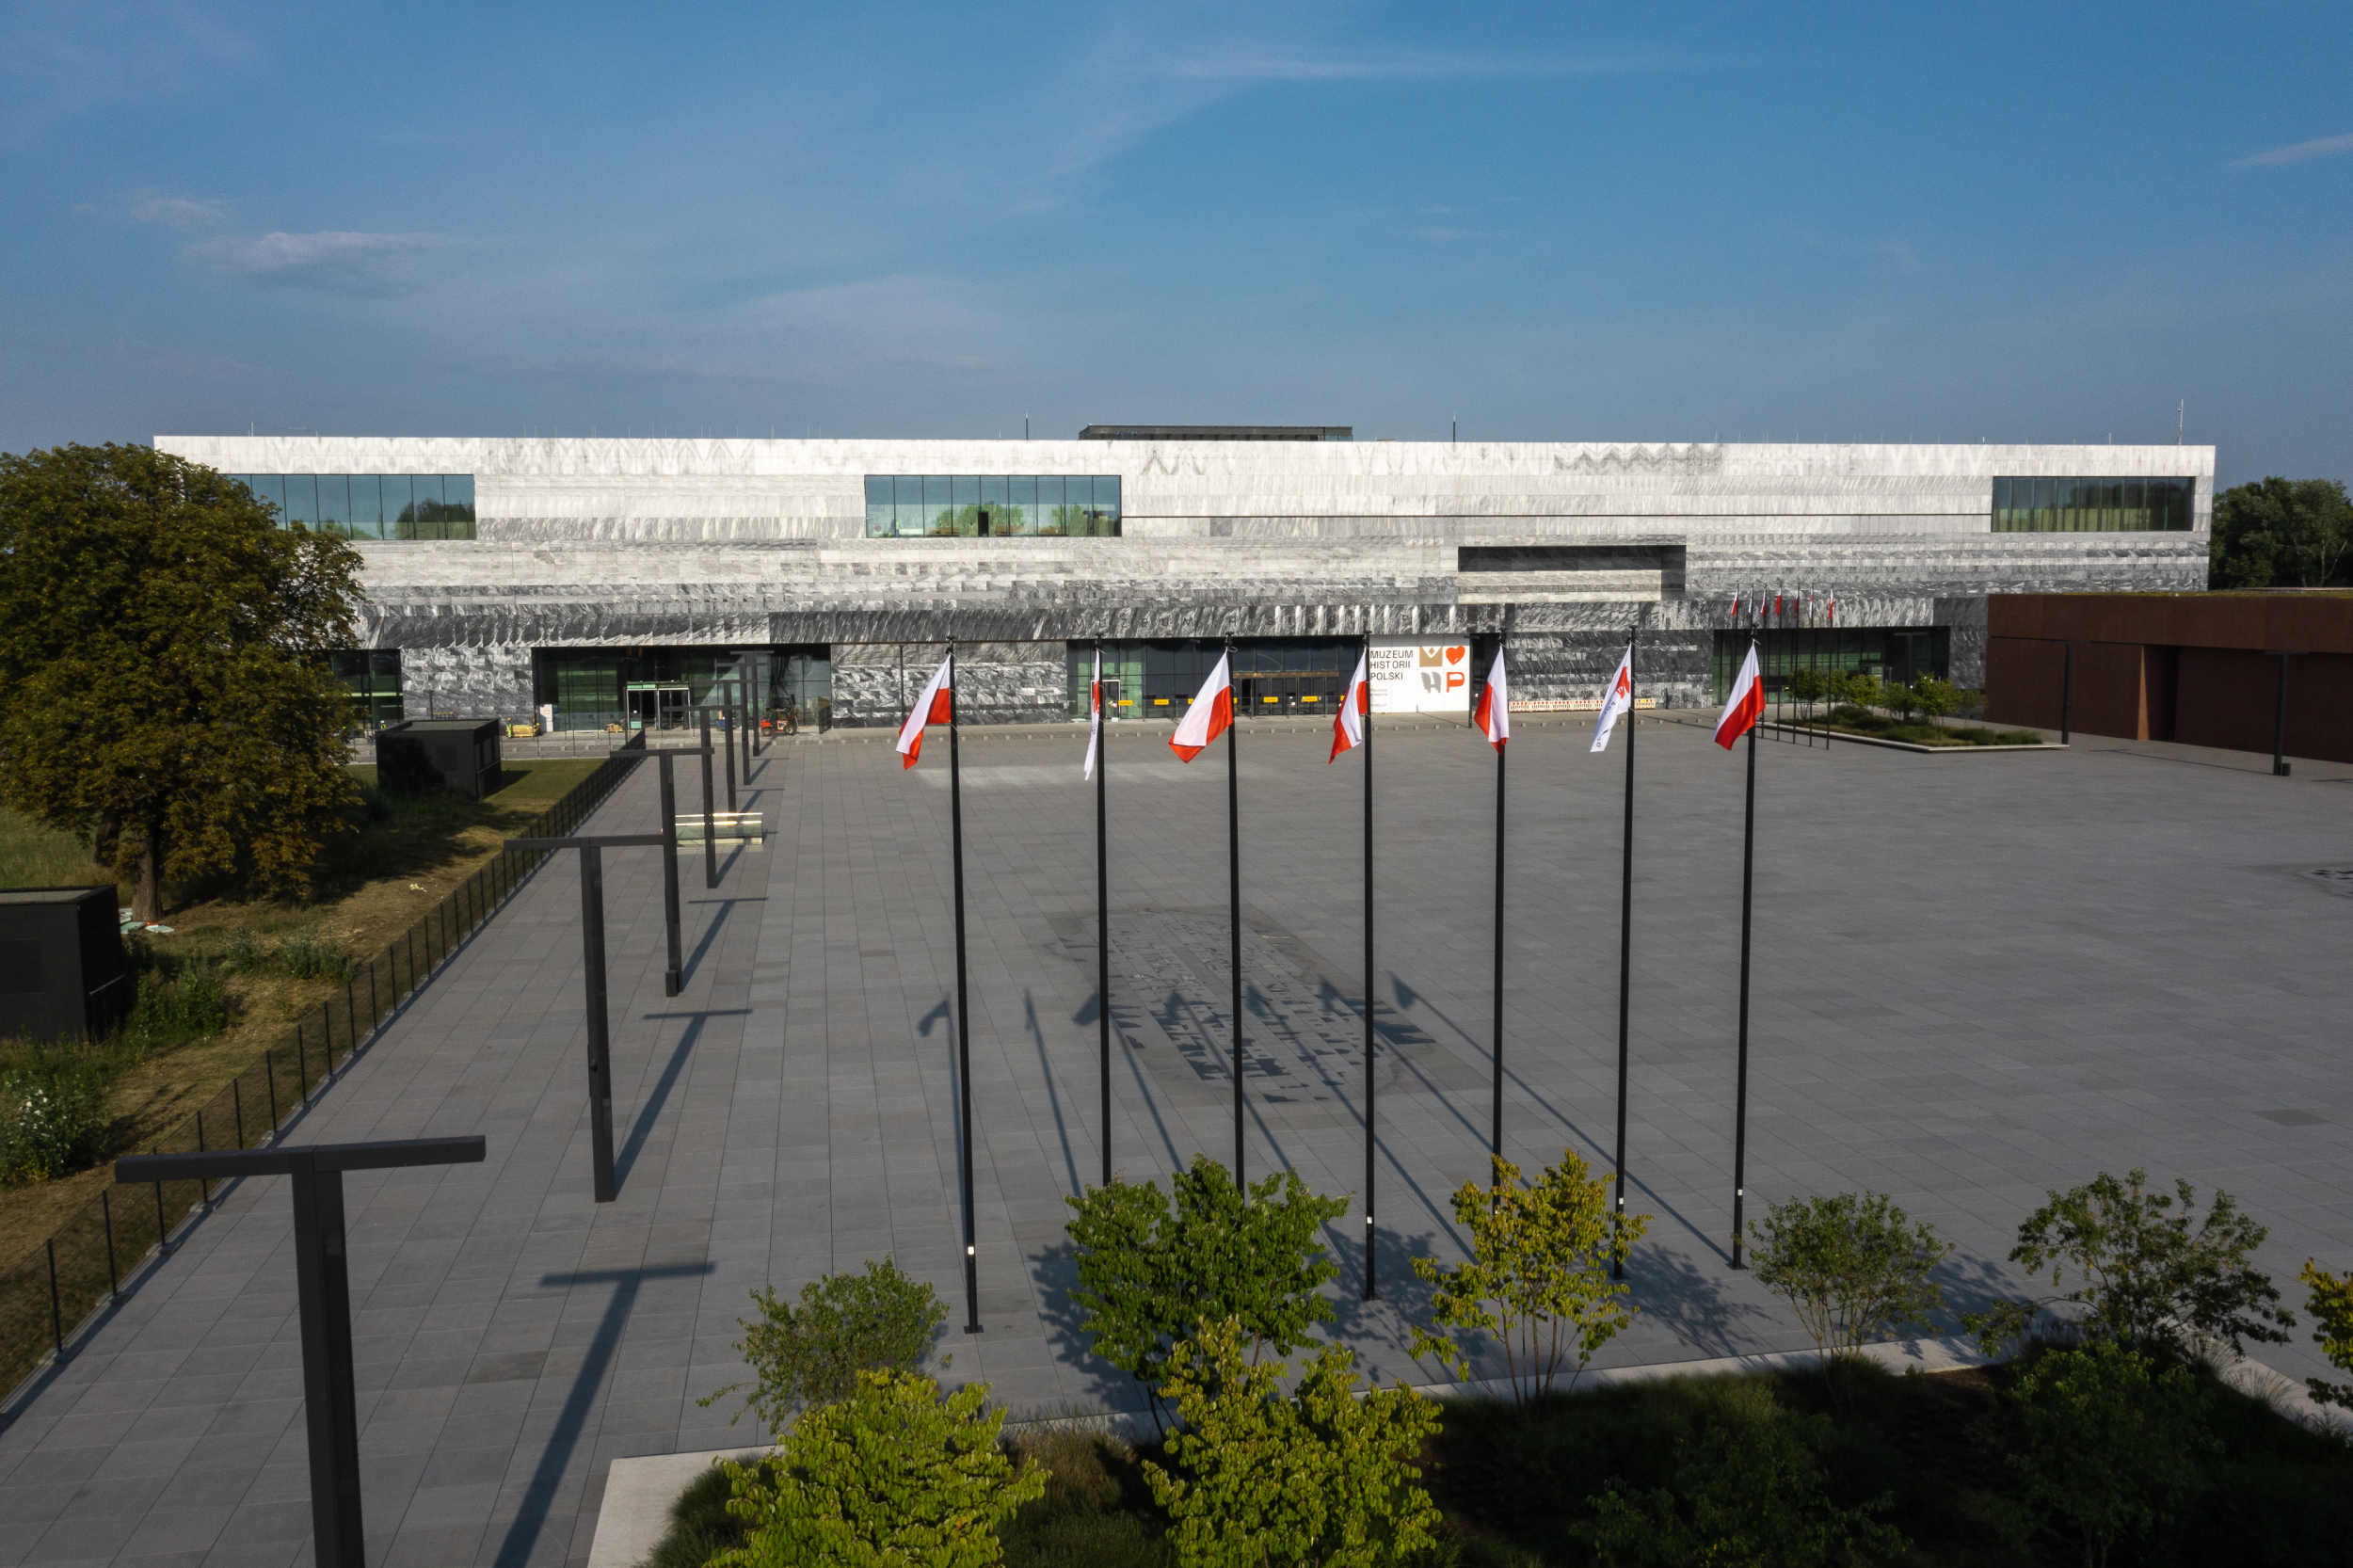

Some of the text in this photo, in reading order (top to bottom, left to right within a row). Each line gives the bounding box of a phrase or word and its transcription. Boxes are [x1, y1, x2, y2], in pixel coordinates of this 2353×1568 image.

[1074, 617, 1194, 628] MUZEUM
[1370, 650, 1413, 659] MUZEUM
[1370, 661, 1410, 669] HISTORII
[1370, 672, 1403, 680] POLSKI
